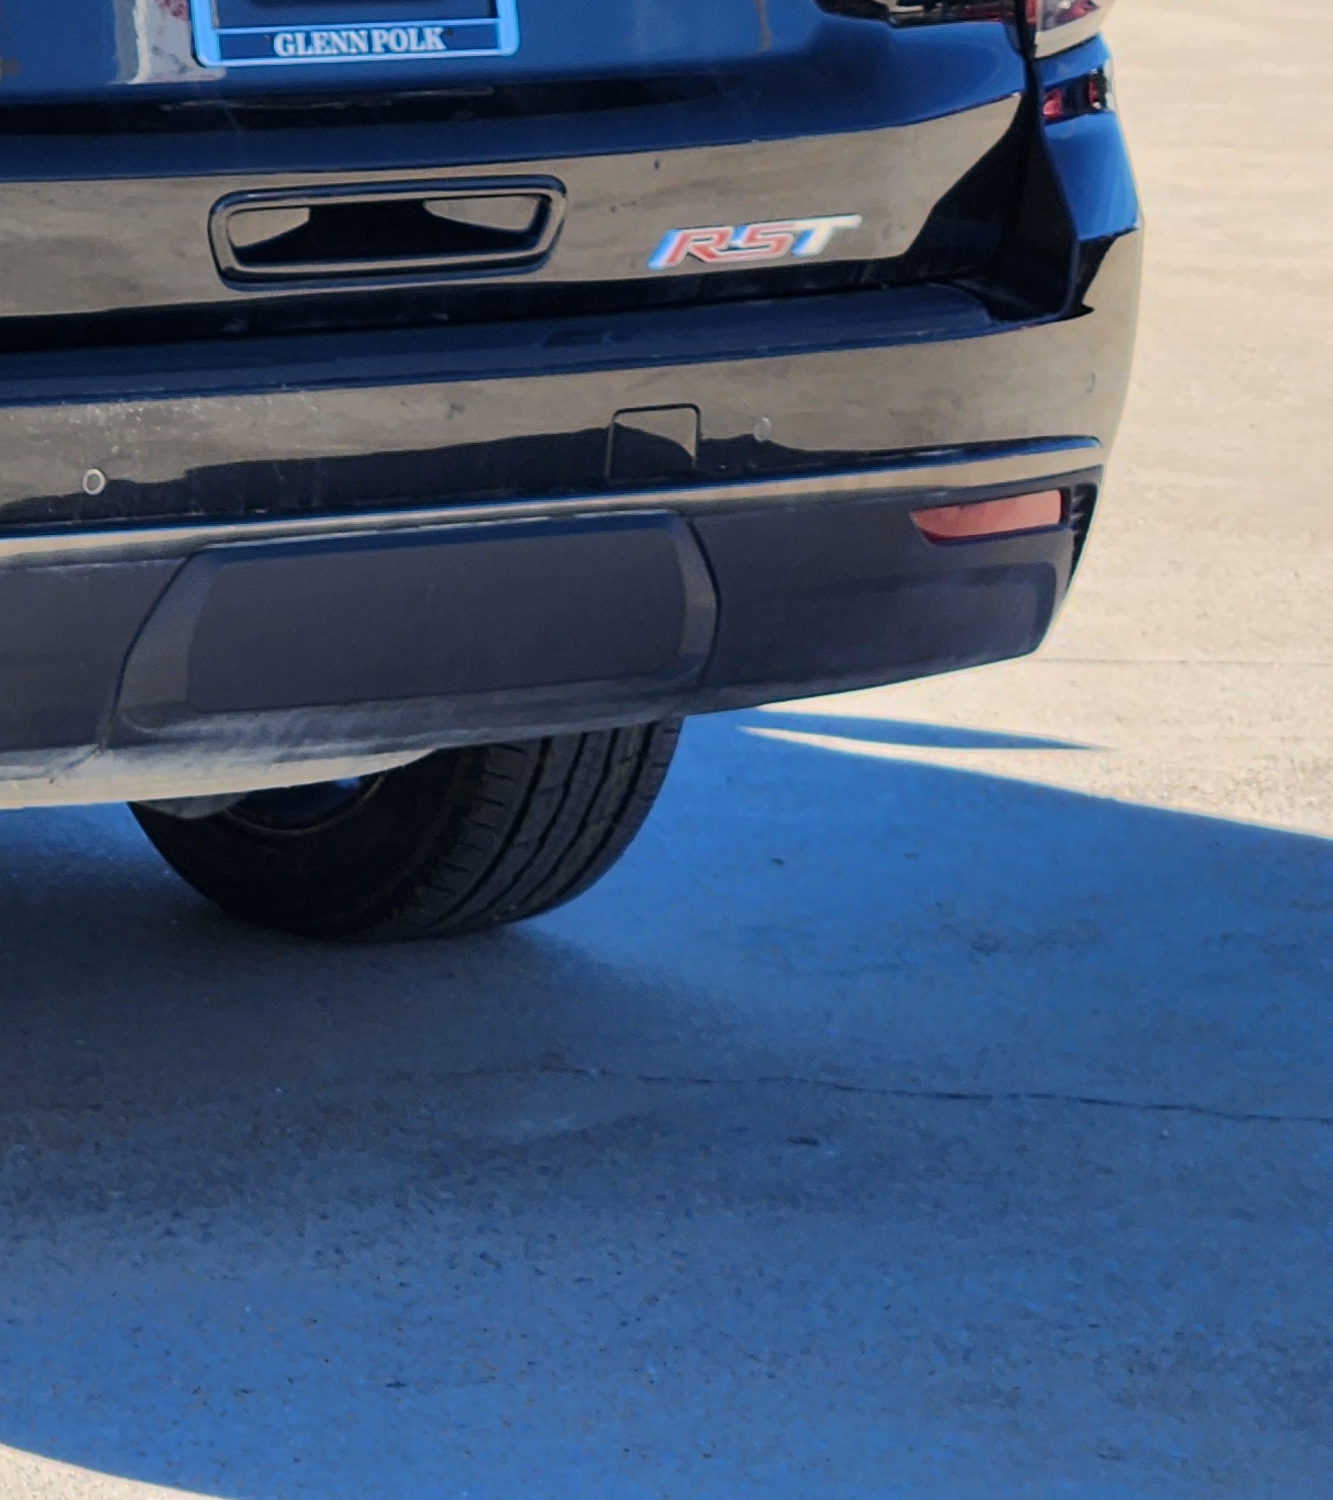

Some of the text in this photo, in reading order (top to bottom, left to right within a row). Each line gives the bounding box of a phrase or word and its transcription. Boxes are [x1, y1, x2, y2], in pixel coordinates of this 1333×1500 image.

[273, 26, 447, 58] GLENN POLK
[647, 214, 863, 271] RST
